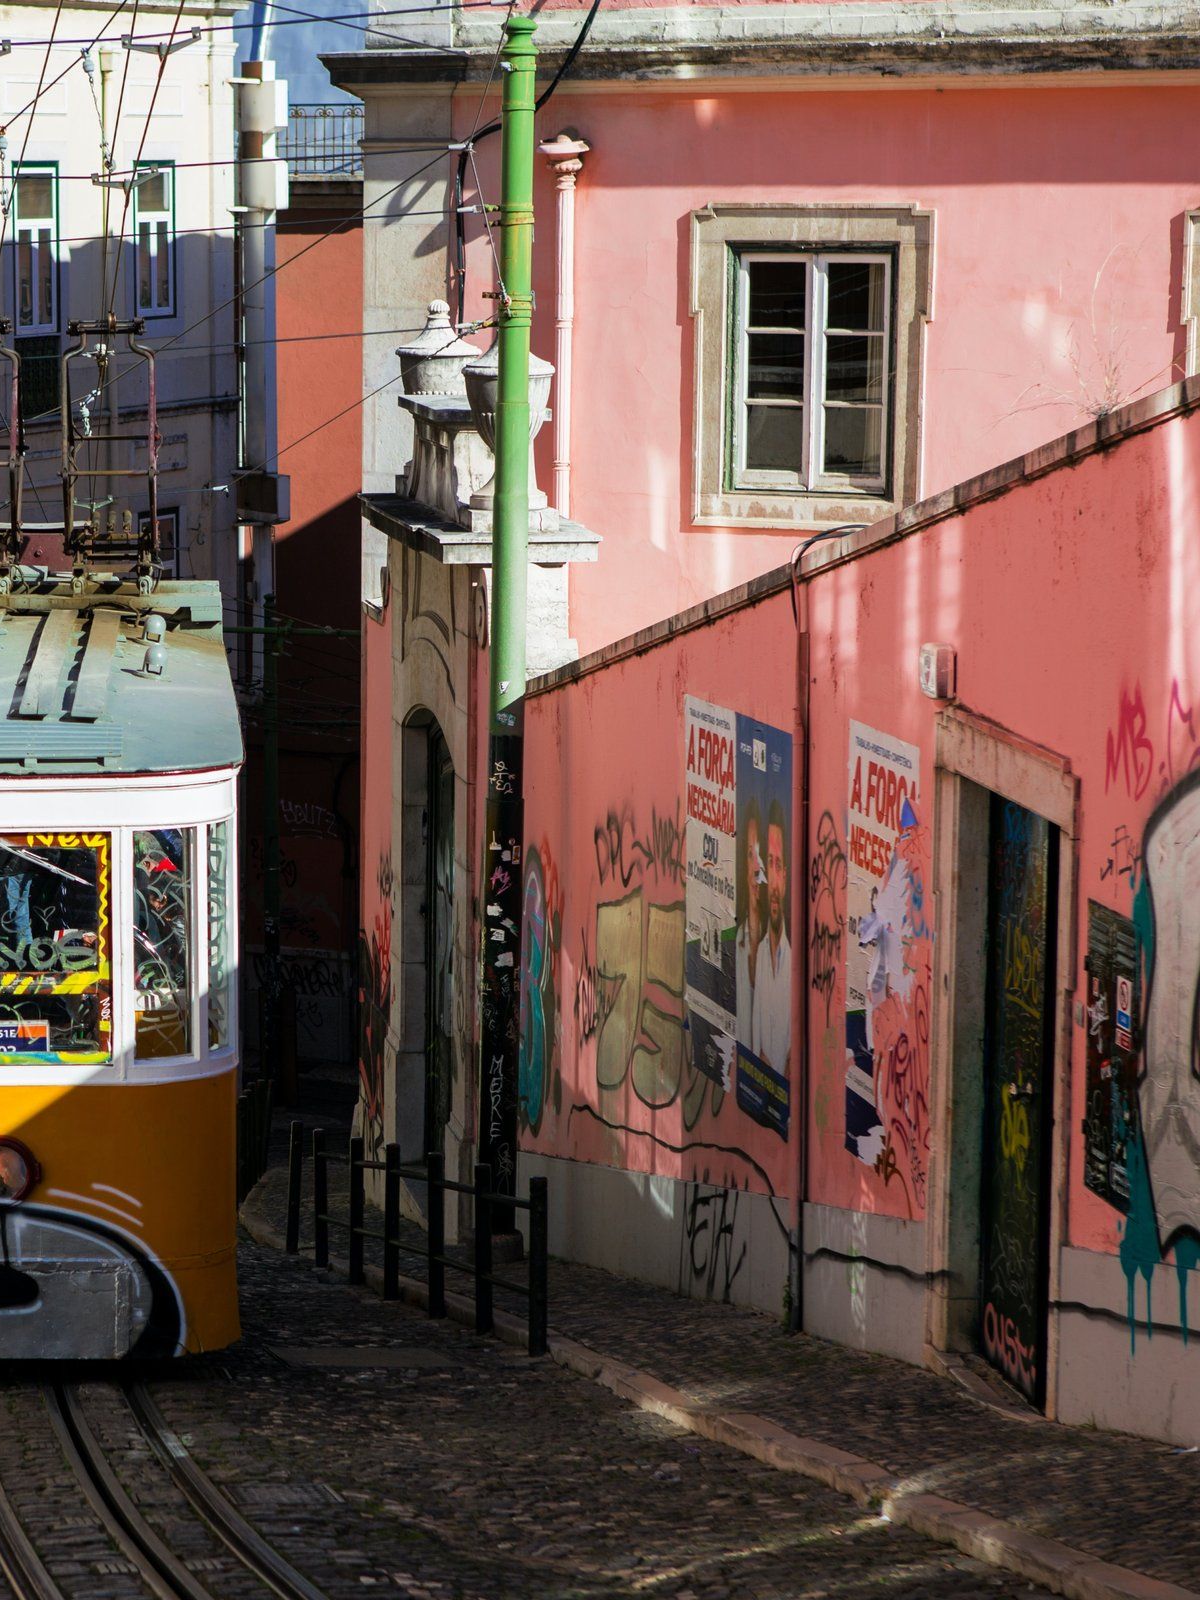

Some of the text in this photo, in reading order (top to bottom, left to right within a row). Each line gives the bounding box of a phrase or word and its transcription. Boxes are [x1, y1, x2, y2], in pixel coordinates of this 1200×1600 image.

[687, 724, 735, 794] A FORÇA
[850, 756, 862, 813] A
[688, 782, 735, 836] NECESSÁRIA
